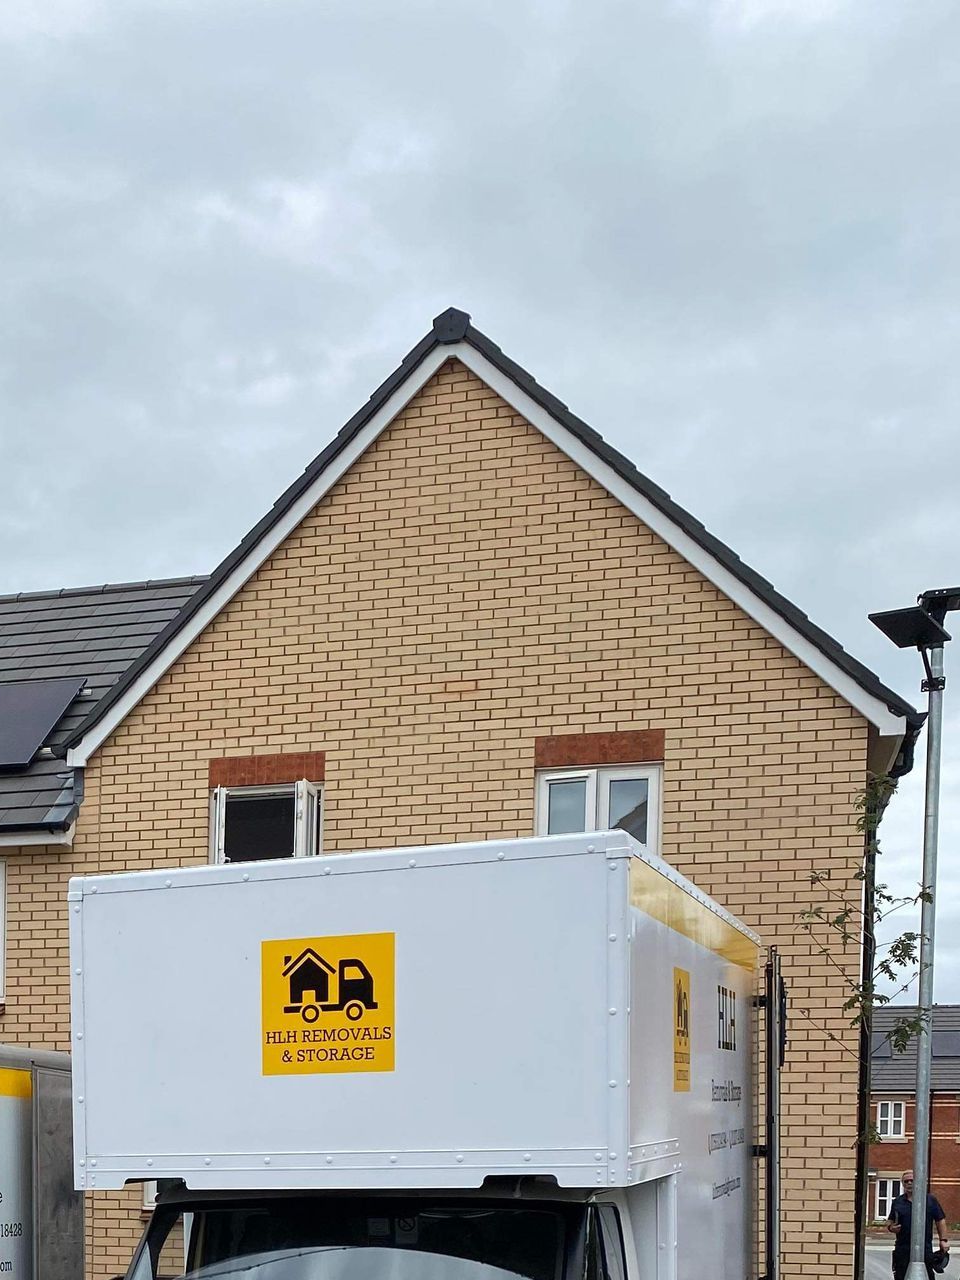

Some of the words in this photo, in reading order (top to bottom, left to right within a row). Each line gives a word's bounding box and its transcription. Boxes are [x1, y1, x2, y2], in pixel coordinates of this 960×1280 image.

[266, 1030, 298, 1044] HLH
[301, 1027, 392, 1043] REMOVALS
[281, 1049, 293, 1063] &
[297, 1046, 375, 1062] STORAGE
